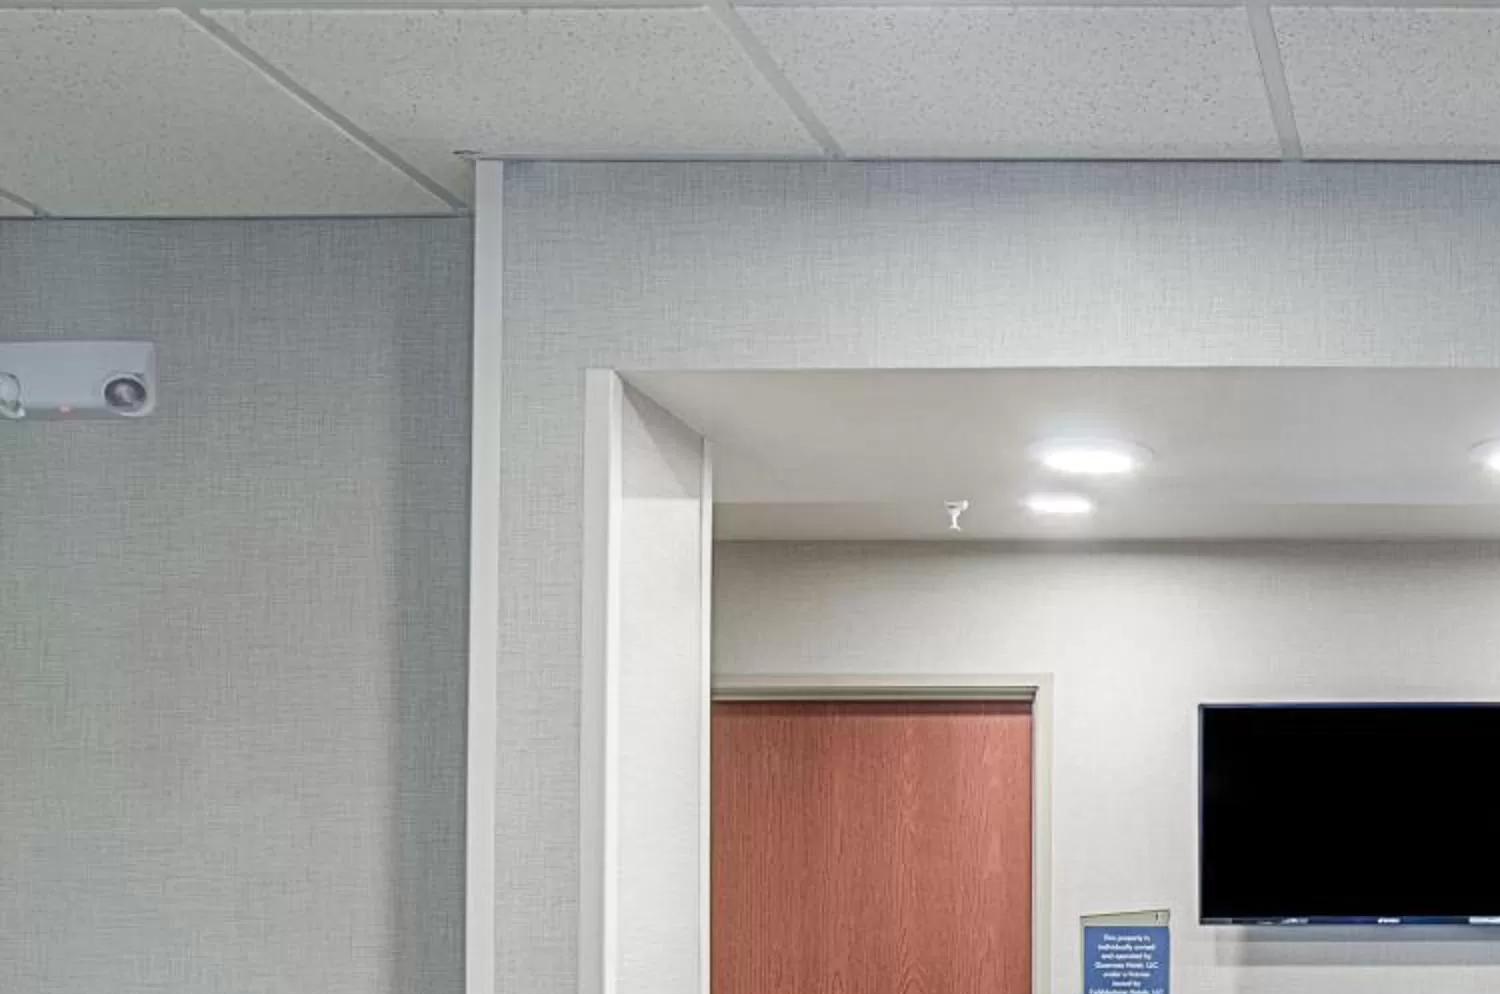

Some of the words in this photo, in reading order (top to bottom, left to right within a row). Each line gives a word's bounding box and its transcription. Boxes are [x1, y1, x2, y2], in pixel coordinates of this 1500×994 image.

[1117, 934, 1143, 943] property
[1097, 943, 1133, 952] individually
[1115, 953, 1142, 961] operated
[1143, 953, 1152, 961] by
